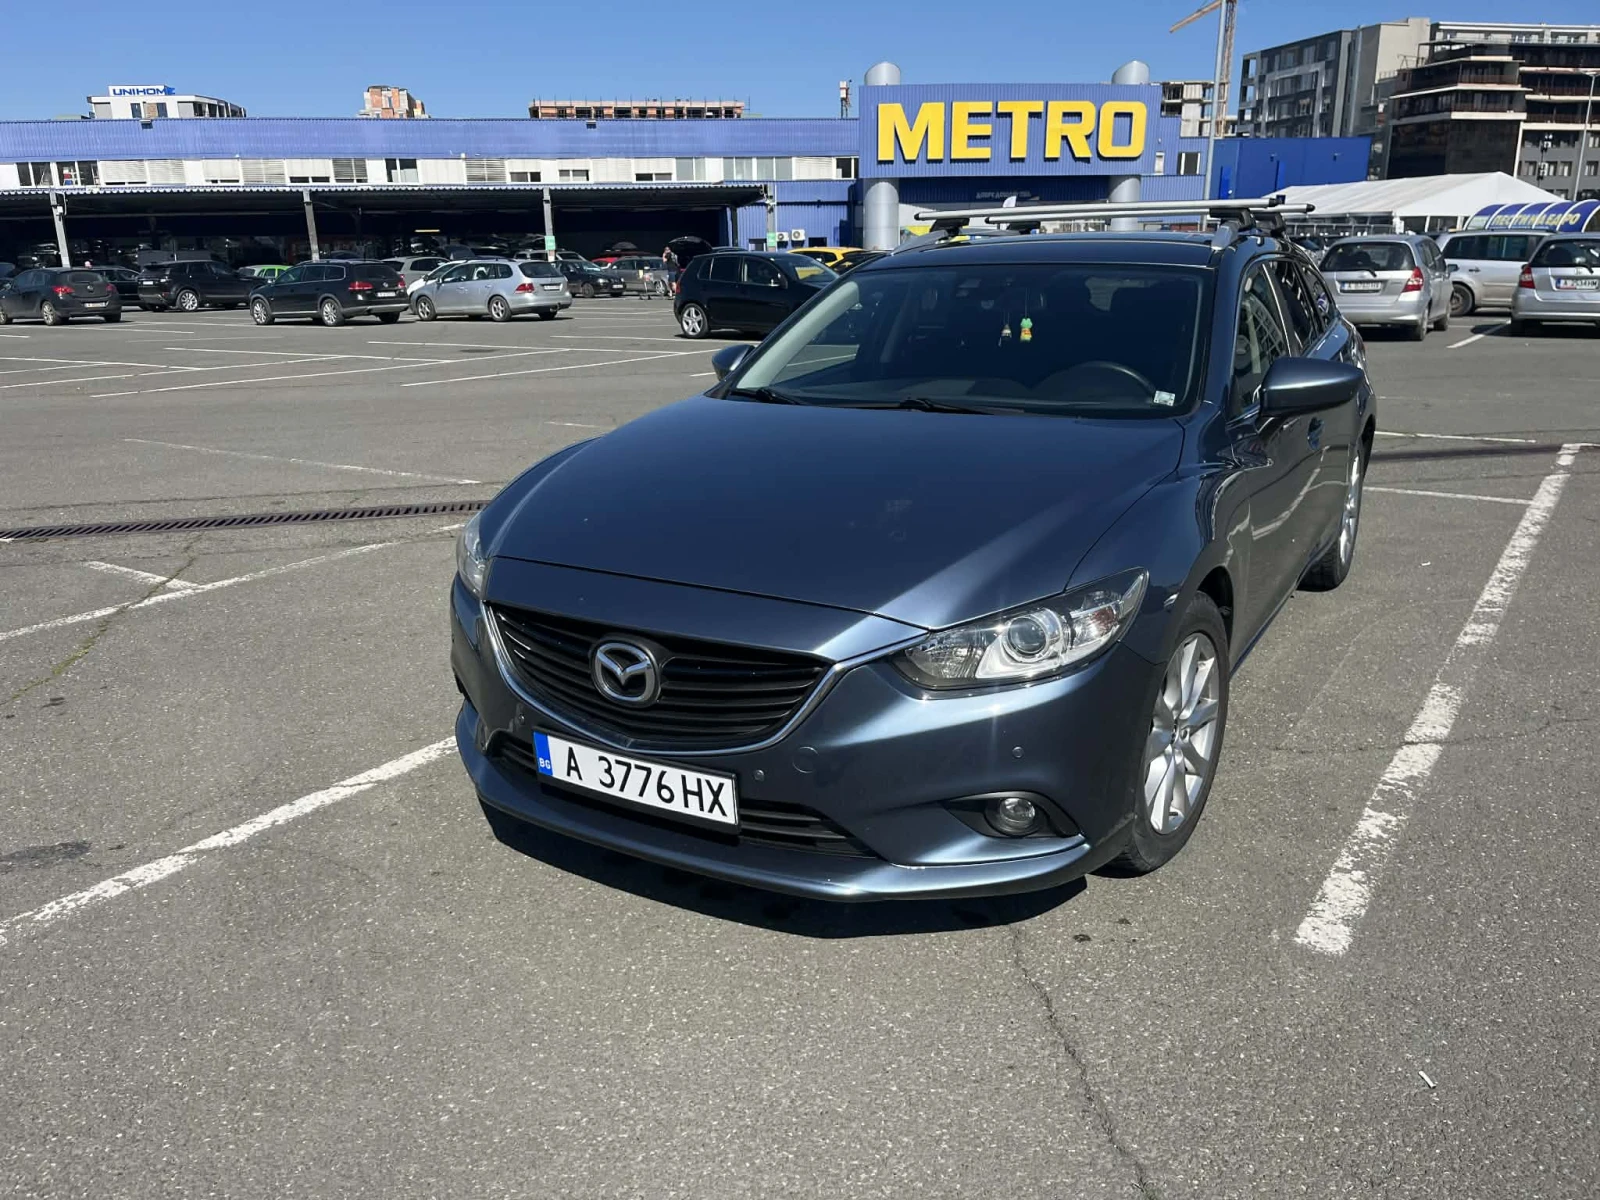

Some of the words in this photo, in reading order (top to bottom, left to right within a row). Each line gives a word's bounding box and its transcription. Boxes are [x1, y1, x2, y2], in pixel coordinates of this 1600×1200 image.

[877, 100, 1147, 161] METRO
[539, 757, 551, 770] BG
[566, 746, 583, 781] A
